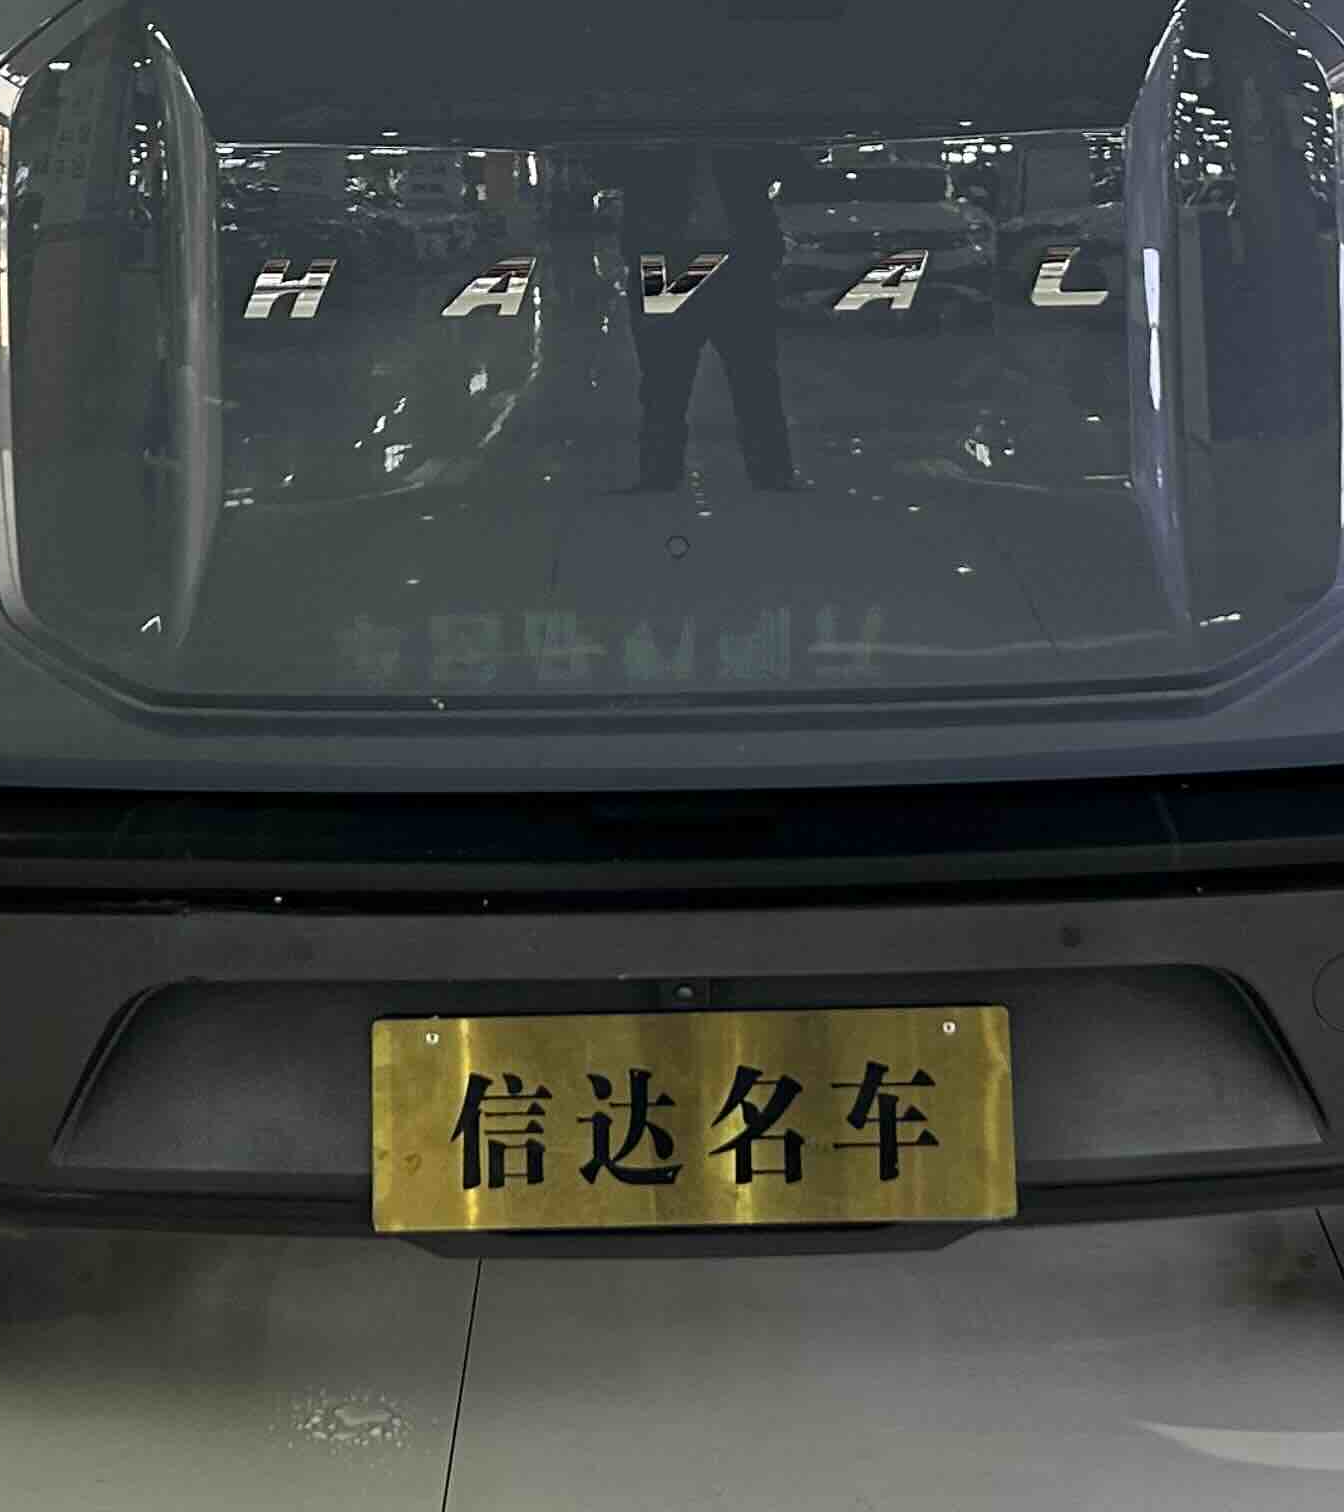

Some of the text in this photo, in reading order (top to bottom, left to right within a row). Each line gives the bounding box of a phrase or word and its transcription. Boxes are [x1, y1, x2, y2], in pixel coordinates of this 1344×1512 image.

[243, 247, 1109, 319] HAVAL
[450, 1060, 940, 1191] 信达名车
